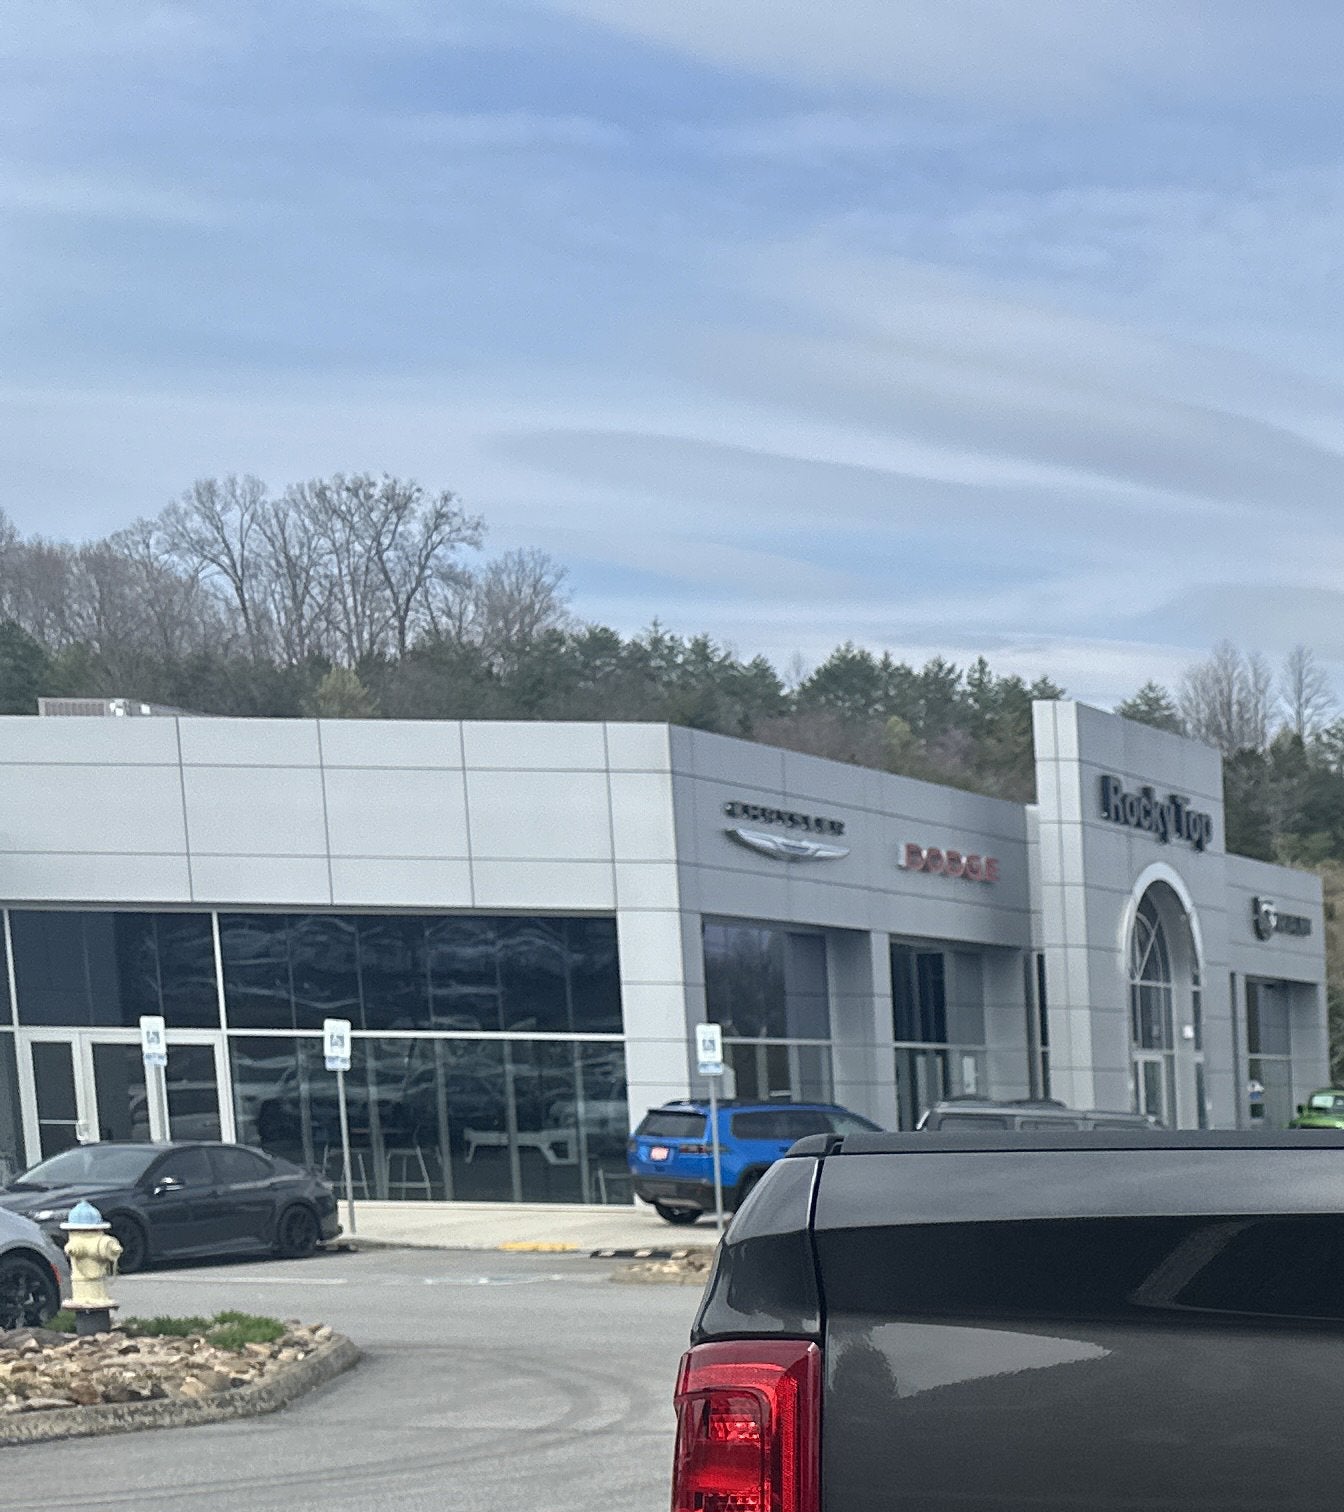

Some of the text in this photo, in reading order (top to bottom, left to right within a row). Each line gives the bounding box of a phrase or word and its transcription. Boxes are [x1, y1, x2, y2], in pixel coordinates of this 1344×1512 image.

[1098, 774, 1213, 853] Rocky Top
[899, 842, 1000, 883] DODGE
